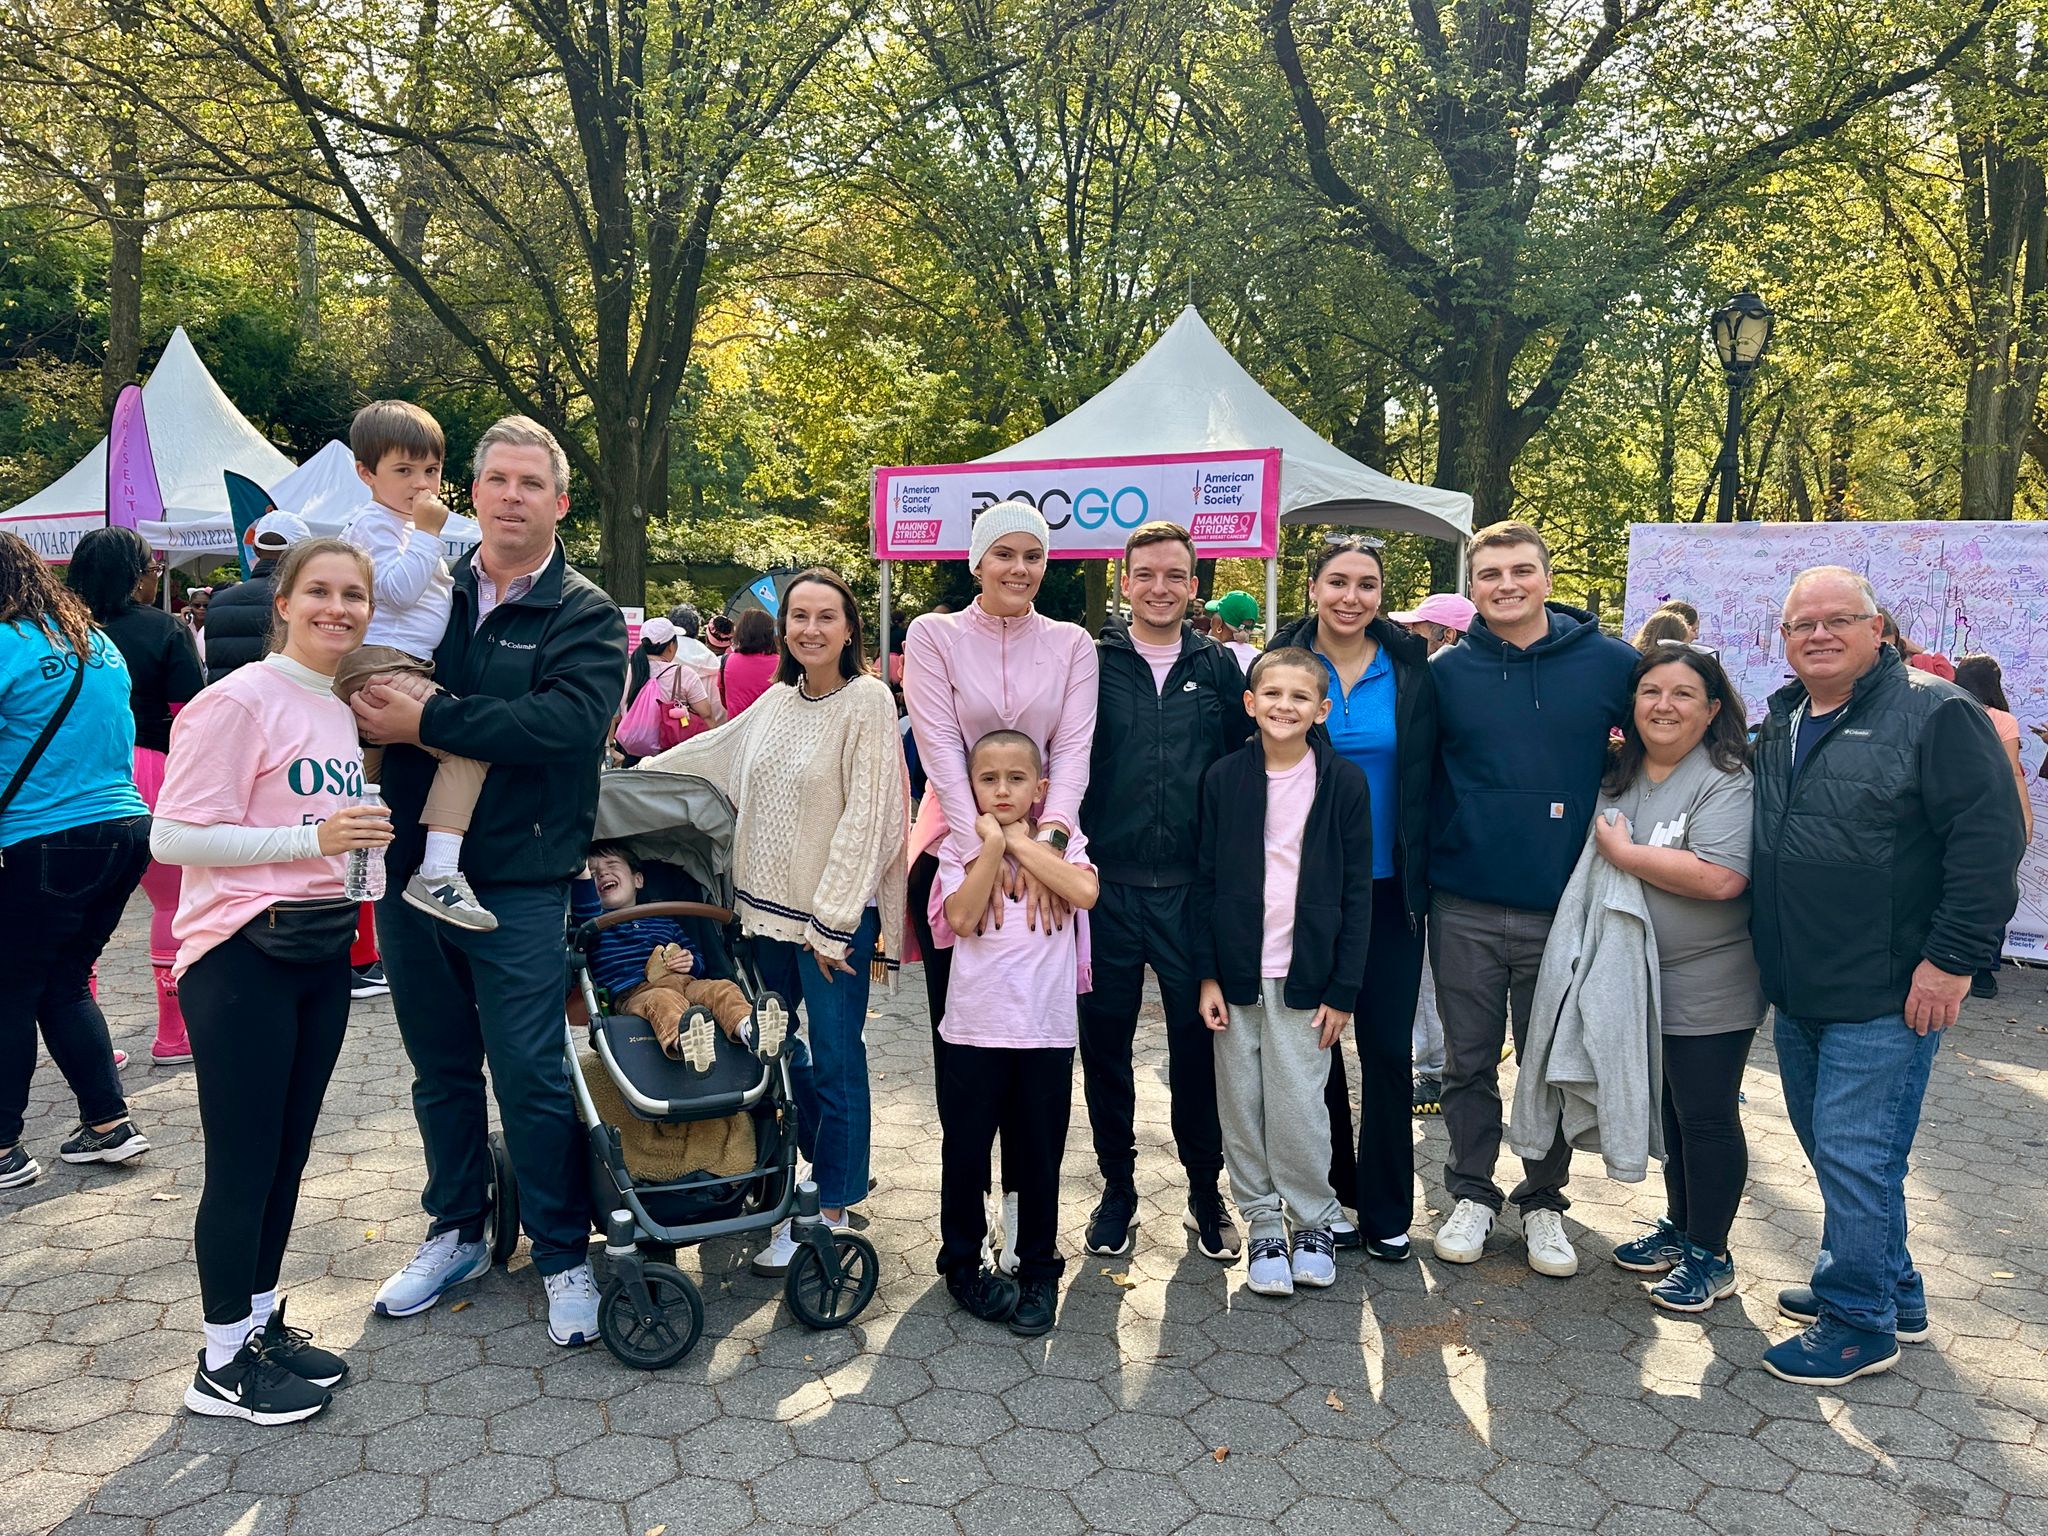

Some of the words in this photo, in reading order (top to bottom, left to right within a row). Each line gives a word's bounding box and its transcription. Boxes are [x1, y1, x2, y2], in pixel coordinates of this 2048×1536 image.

[1205, 472, 1254, 483] American
[903, 485, 940, 494] American
[1204, 484, 1242, 494] Cancer
[902, 495, 931, 504] Cancer
[1204, 494, 1243, 506] Society
[902, 504, 932, 515] Society
[1196, 515, 1239, 525] MAKING
[897, 522, 929, 531] MAKING
[1193, 524, 1236, 535] STRIDES
[179, 528, 234, 547] NOVARTIS
[895, 530, 927, 539] STRIDES
[25, 530, 90, 554] NOVART
